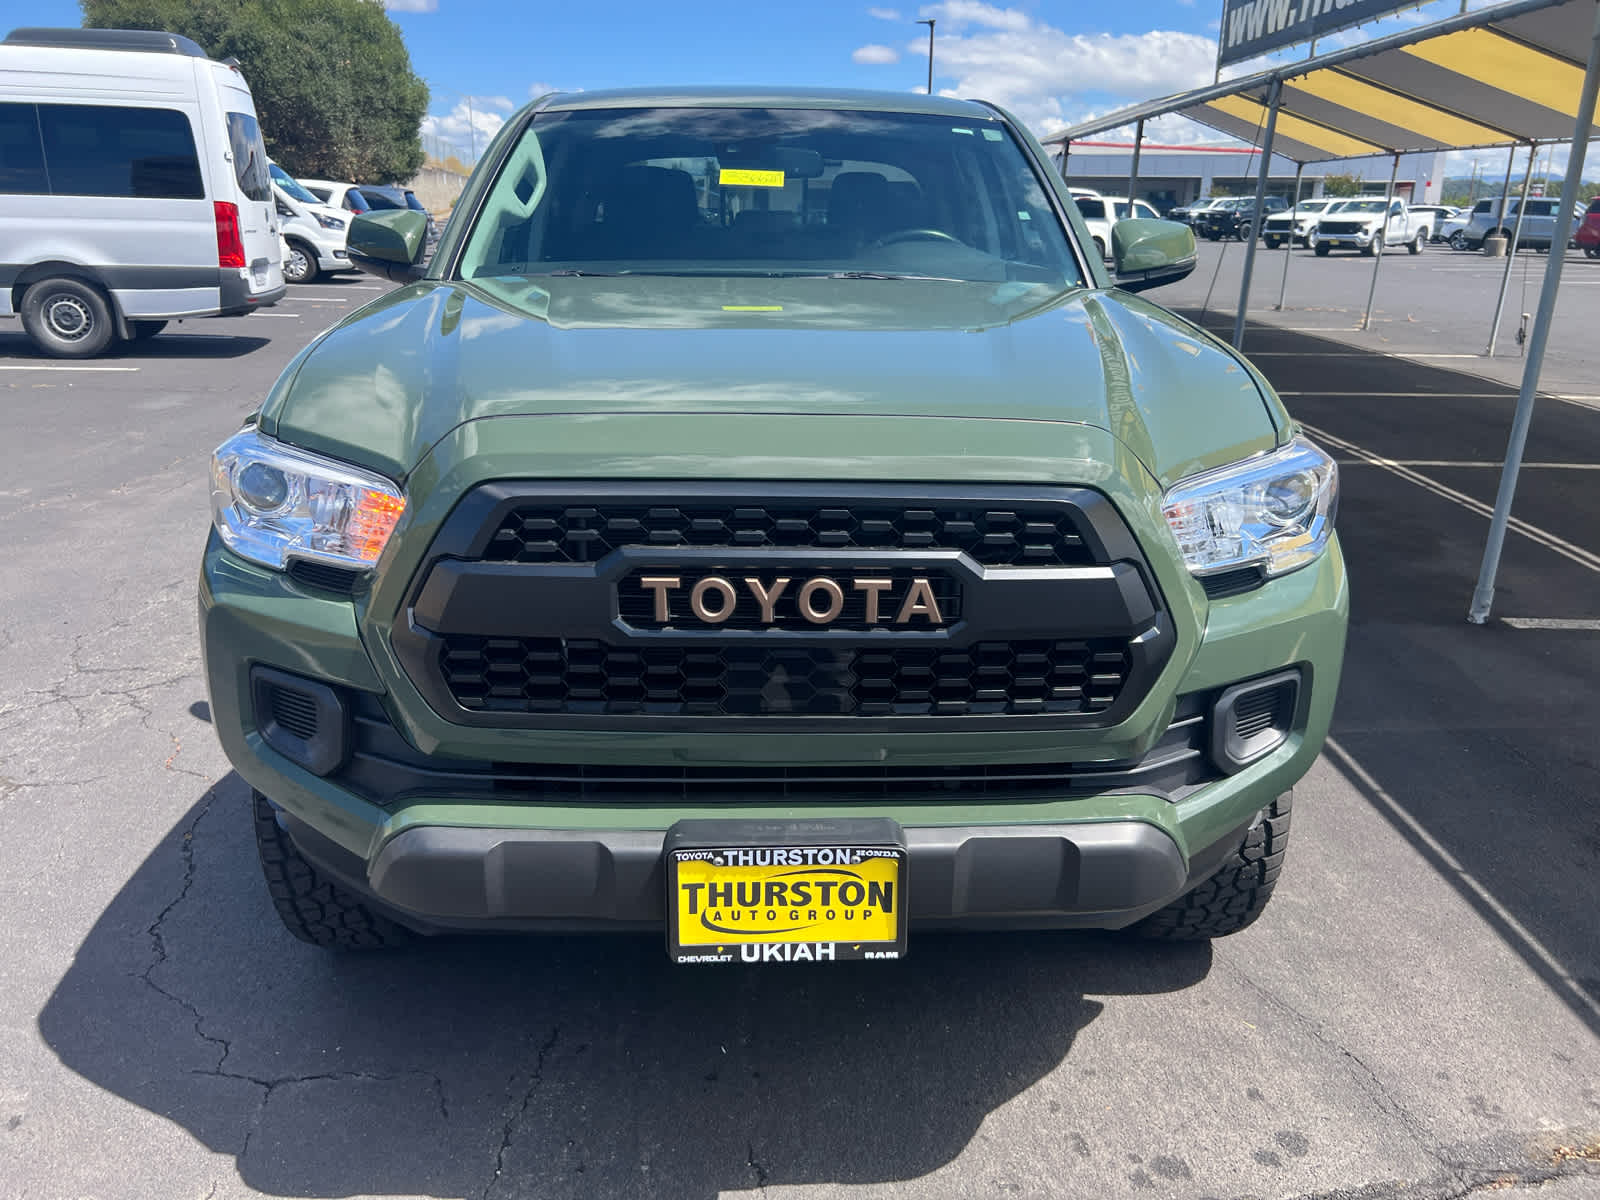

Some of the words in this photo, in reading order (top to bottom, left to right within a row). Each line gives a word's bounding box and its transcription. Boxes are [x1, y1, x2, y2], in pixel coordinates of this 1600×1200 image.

[641, 577, 943, 623] TOYOTA
[676, 851, 714, 861] TOYOTA
[723, 848, 850, 866] THURSTON
[856, 850, 900, 858] HONDA
[682, 881, 893, 914] THURSTON
[713, 910, 777, 921] AUTO
[789, 909, 873, 921] GROUP
[678, 954, 733, 963] CHEVROLET
[741, 943, 836, 962] UKIAH
[864, 951, 899, 959] RAM
